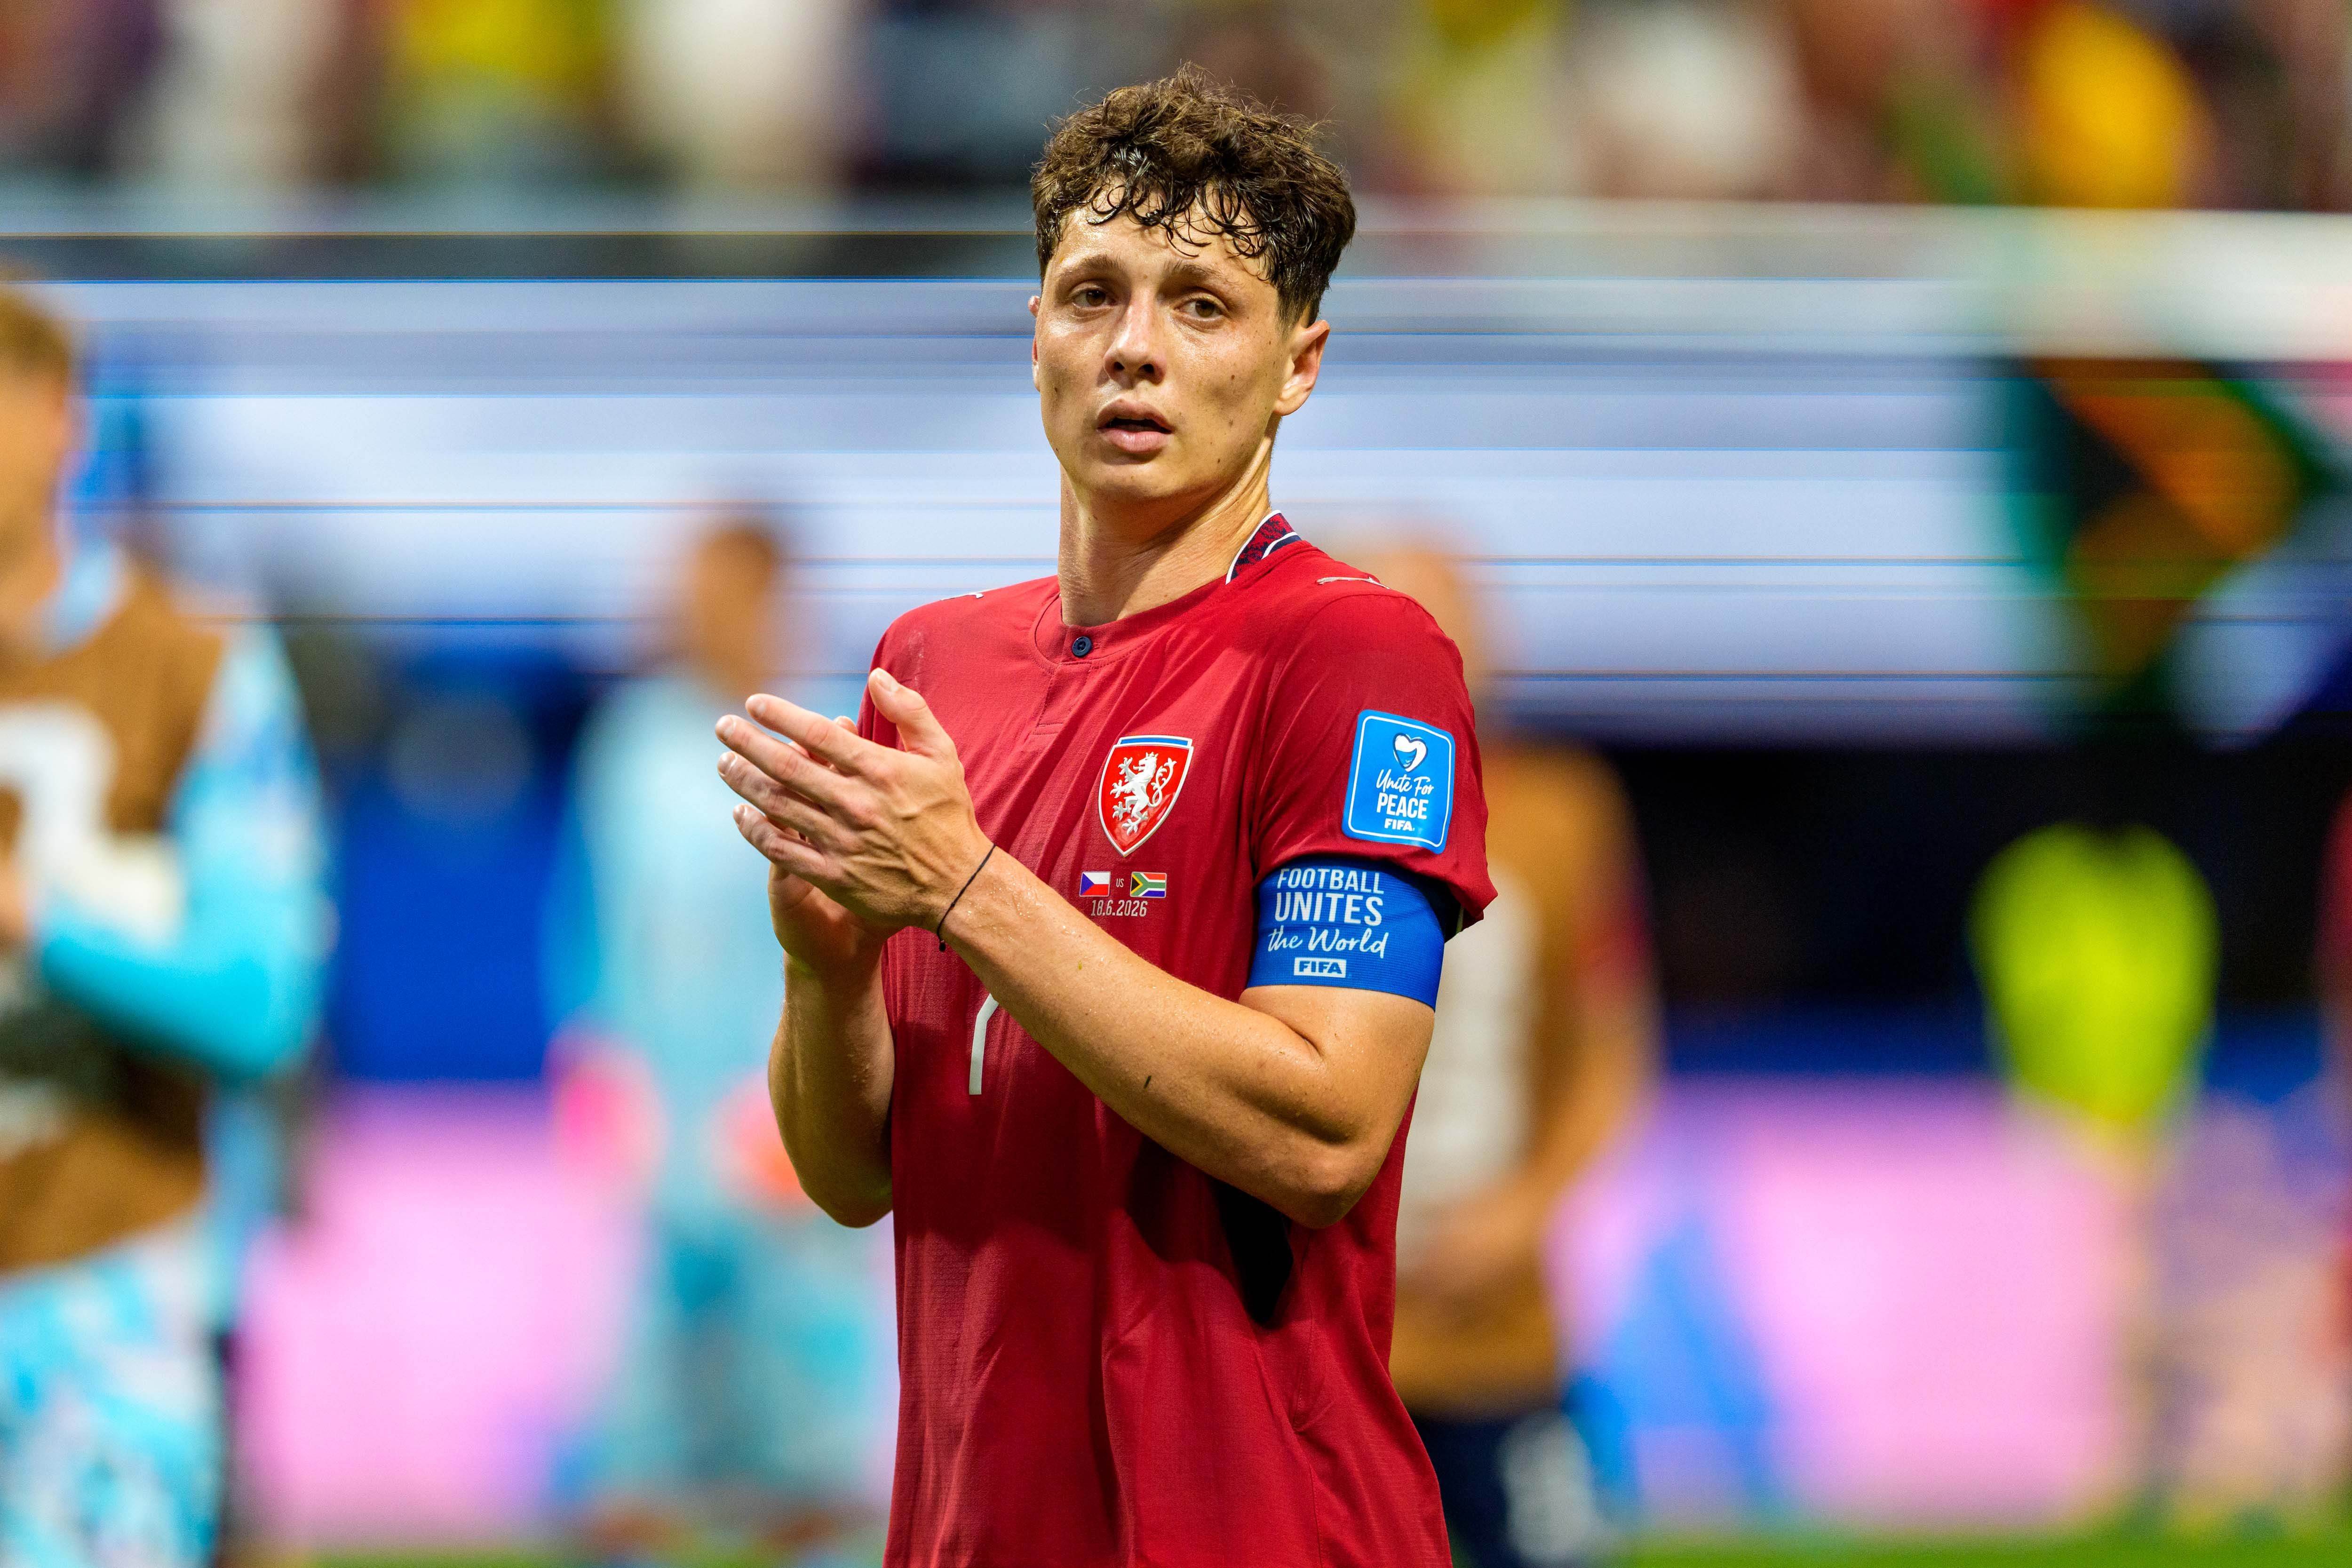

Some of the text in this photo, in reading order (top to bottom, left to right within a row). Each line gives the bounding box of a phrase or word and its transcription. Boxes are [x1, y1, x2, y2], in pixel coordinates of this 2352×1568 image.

[1376, 769, 1434, 796] Unite For
[1376, 792, 1429, 820] PEACE
[1277, 868, 1384, 894] FOOTBALL
[1091, 899, 1148, 917] 18.6.2026
[1274, 891, 1383, 926] UNITES
[1268, 925, 1389, 959] the World
[1299, 960, 1342, 974] FIFA
